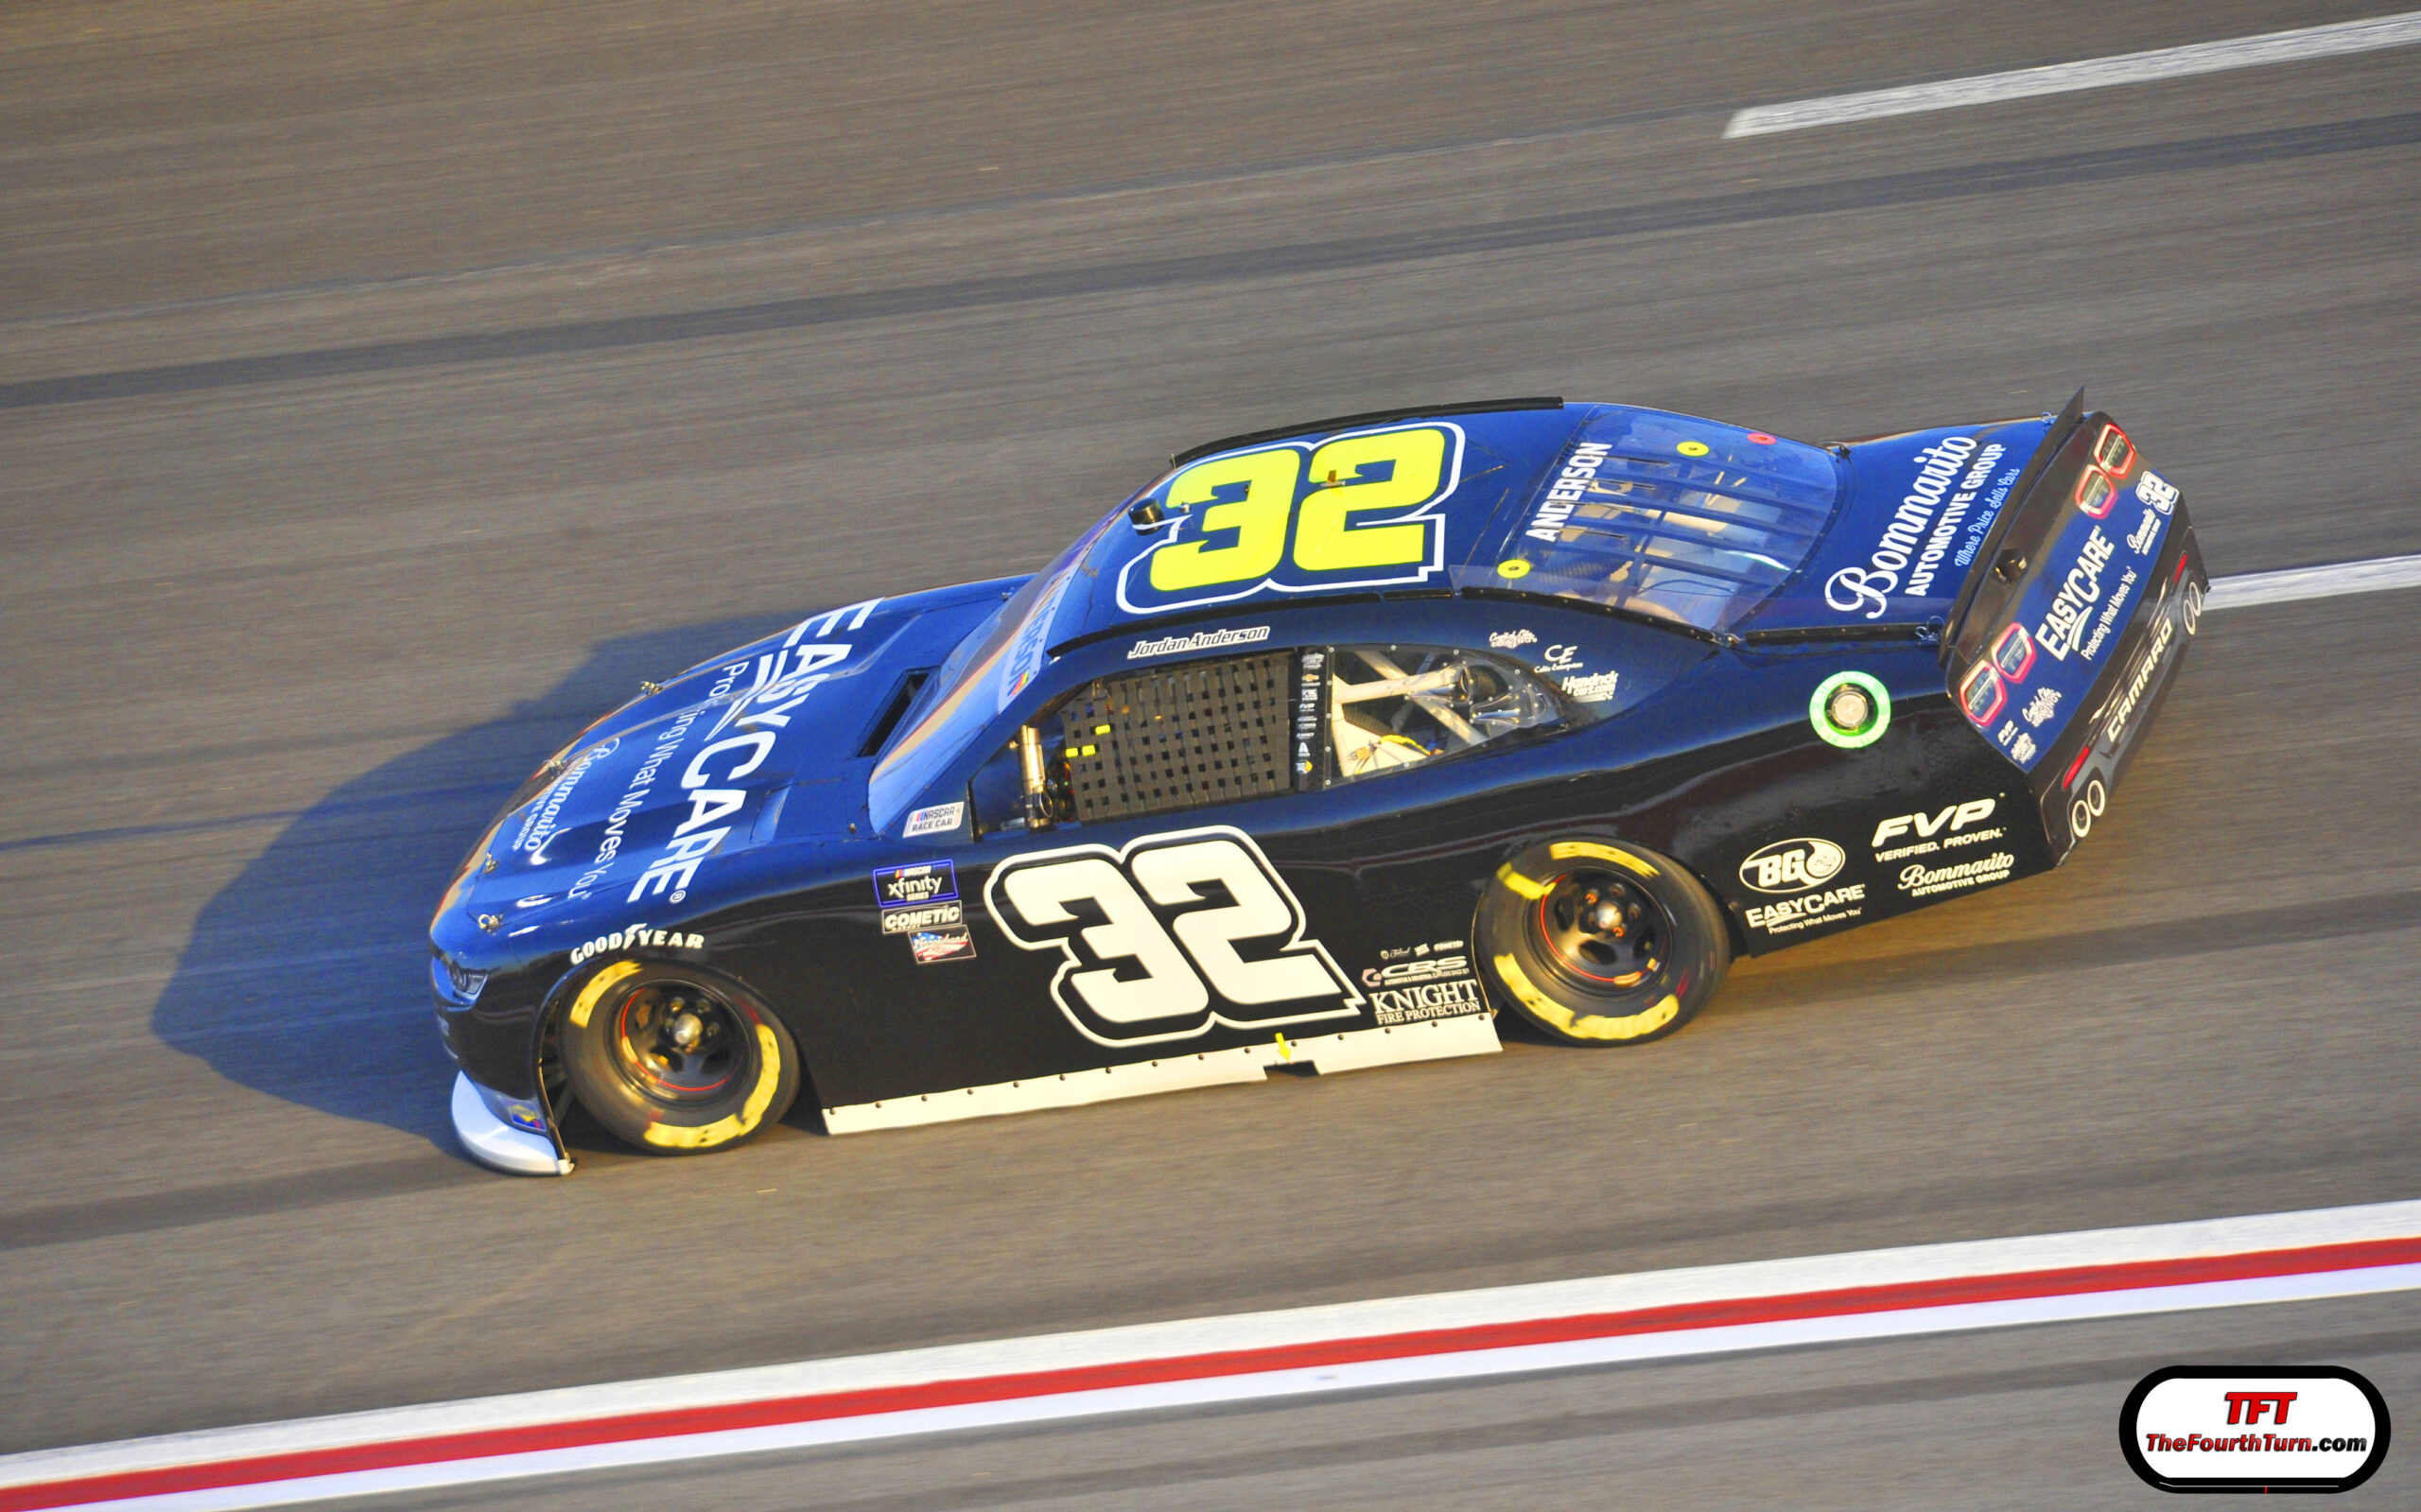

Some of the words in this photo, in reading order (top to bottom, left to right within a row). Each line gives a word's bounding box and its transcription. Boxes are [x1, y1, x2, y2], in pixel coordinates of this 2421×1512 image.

[1525, 443, 1612, 542] ANDERSON
[1998, 468, 2020, 490] Cars
[2135, 471, 2180, 515] 32
[1140, 426, 1454, 601] 32
[1824, 436, 1978, 618] Bommarito
[1905, 492, 1977, 597] AUTOMOTIVE
[1960, 443, 2007, 490] GROUP
[1967, 510, 1994, 534] Price
[1955, 534, 1980, 566] Where
[2081, 623, 2111, 661] Protecting
[2099, 604, 2118, 625] What
[2109, 582, 2131, 608] Moves
[1127, 637, 1189, 659] Jordan
[1189, 626, 1270, 649] Anderson
[1544, 644, 1577, 665] CE
[2107, 617, 2173, 742] CAMARO
[629, 738, 685, 791] What
[595, 789, 651, 863] Moves
[912, 822, 933, 831] RACE
[934, 818, 953, 827] CAR
[917, 806, 955, 822] NASCAR
[1872, 799, 1995, 847] FVP
[1874, 842, 1940, 862] VERIFIED.
[1942, 827, 2003, 849] PROVEN.
[567, 862, 615, 898] You
[1745, 848, 1807, 887] BG
[1897, 852, 2014, 891] Bommarito
[1911, 877, 1976, 897] AUTOMOTIVE
[1976, 870, 2011, 884] GROUP
[887, 877, 942, 898] xfinity
[885, 906, 960, 930] COMETIC
[993, 832, 1354, 1035] 32
[1381, 955, 1468, 979] CRS
[1368, 979, 1479, 1015] KNIGHT
[1375, 1011, 1405, 1025] FIRE
[1404, 1000, 1481, 1020] PROTECTION
